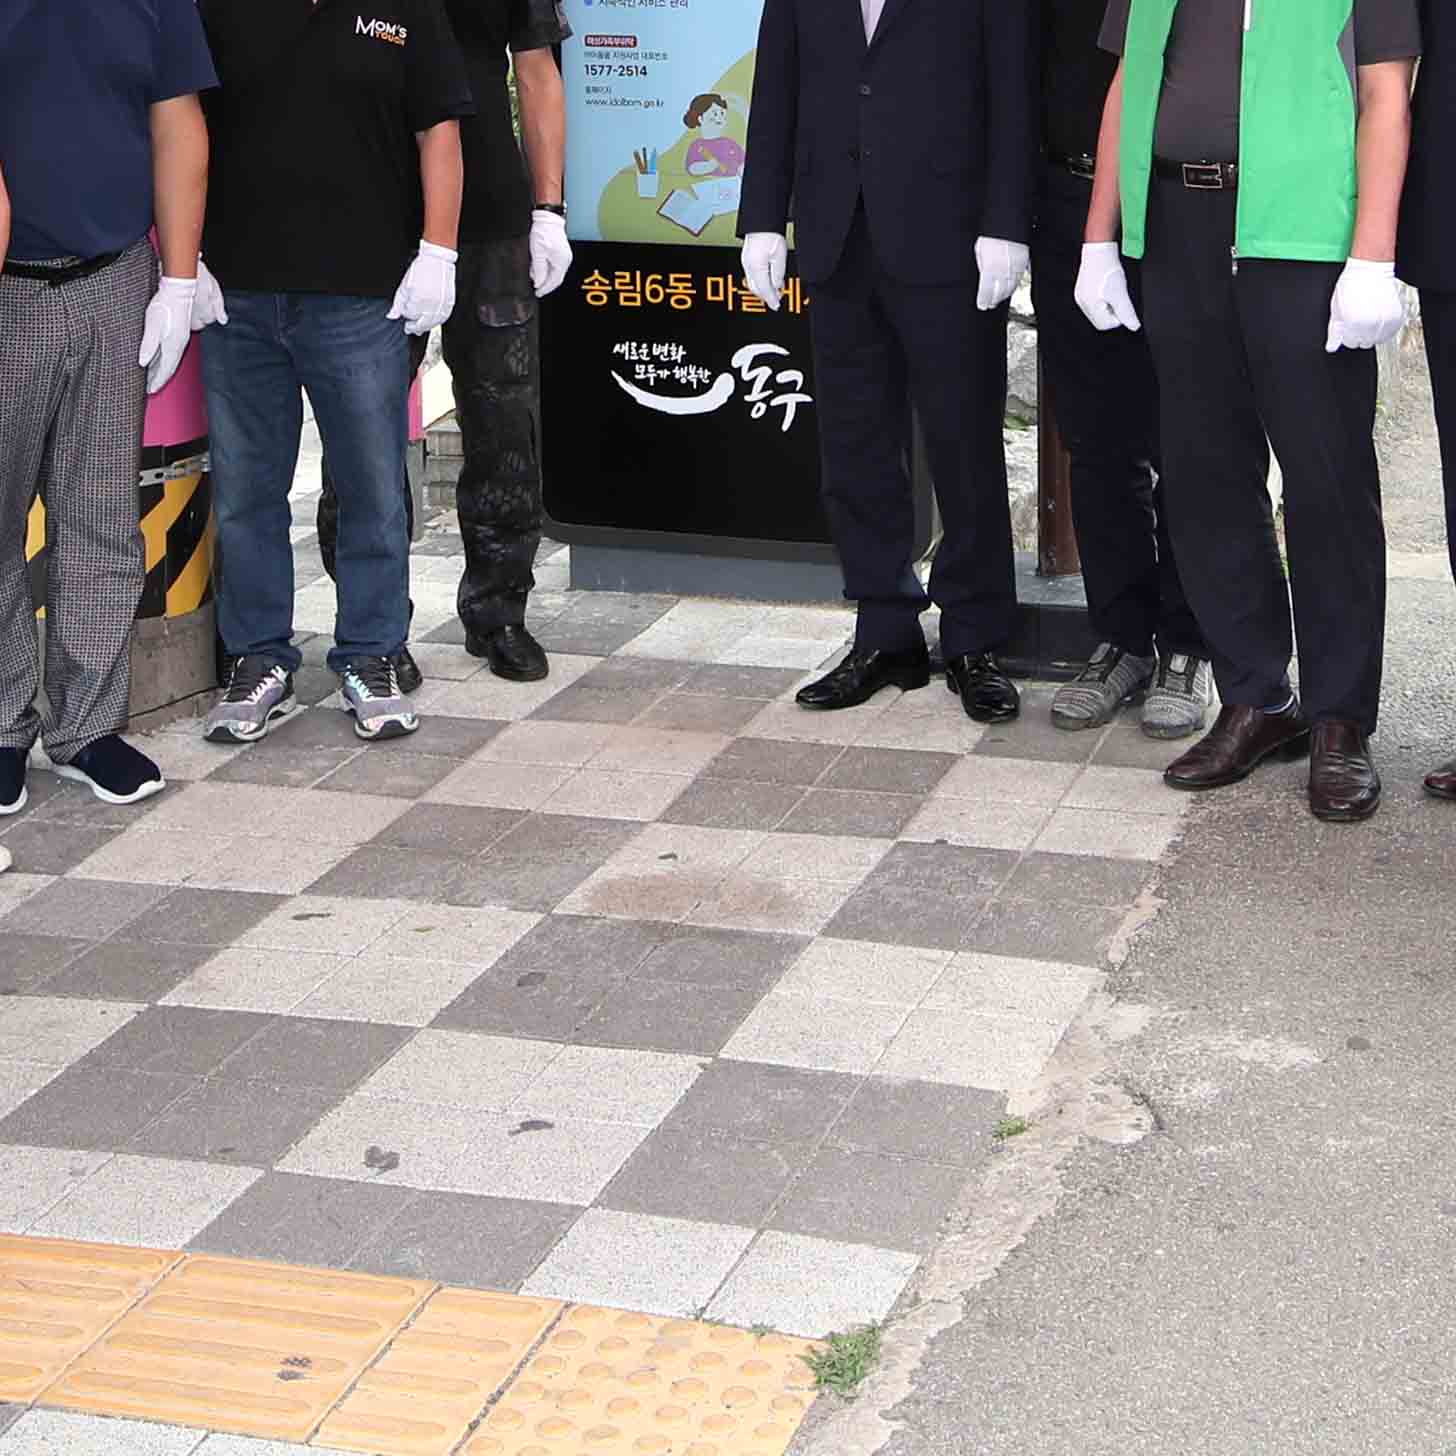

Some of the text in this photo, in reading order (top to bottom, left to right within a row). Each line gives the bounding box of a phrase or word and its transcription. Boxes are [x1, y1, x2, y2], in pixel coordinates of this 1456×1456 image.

[584, 64, 648, 77] 1577-2514
[580, 269, 697, 311] 송림6동
[612, 340, 687, 363] 새로운 변화
[634, 363, 712, 390] 모두가 행복한
[731, 343, 814, 432] 동구
